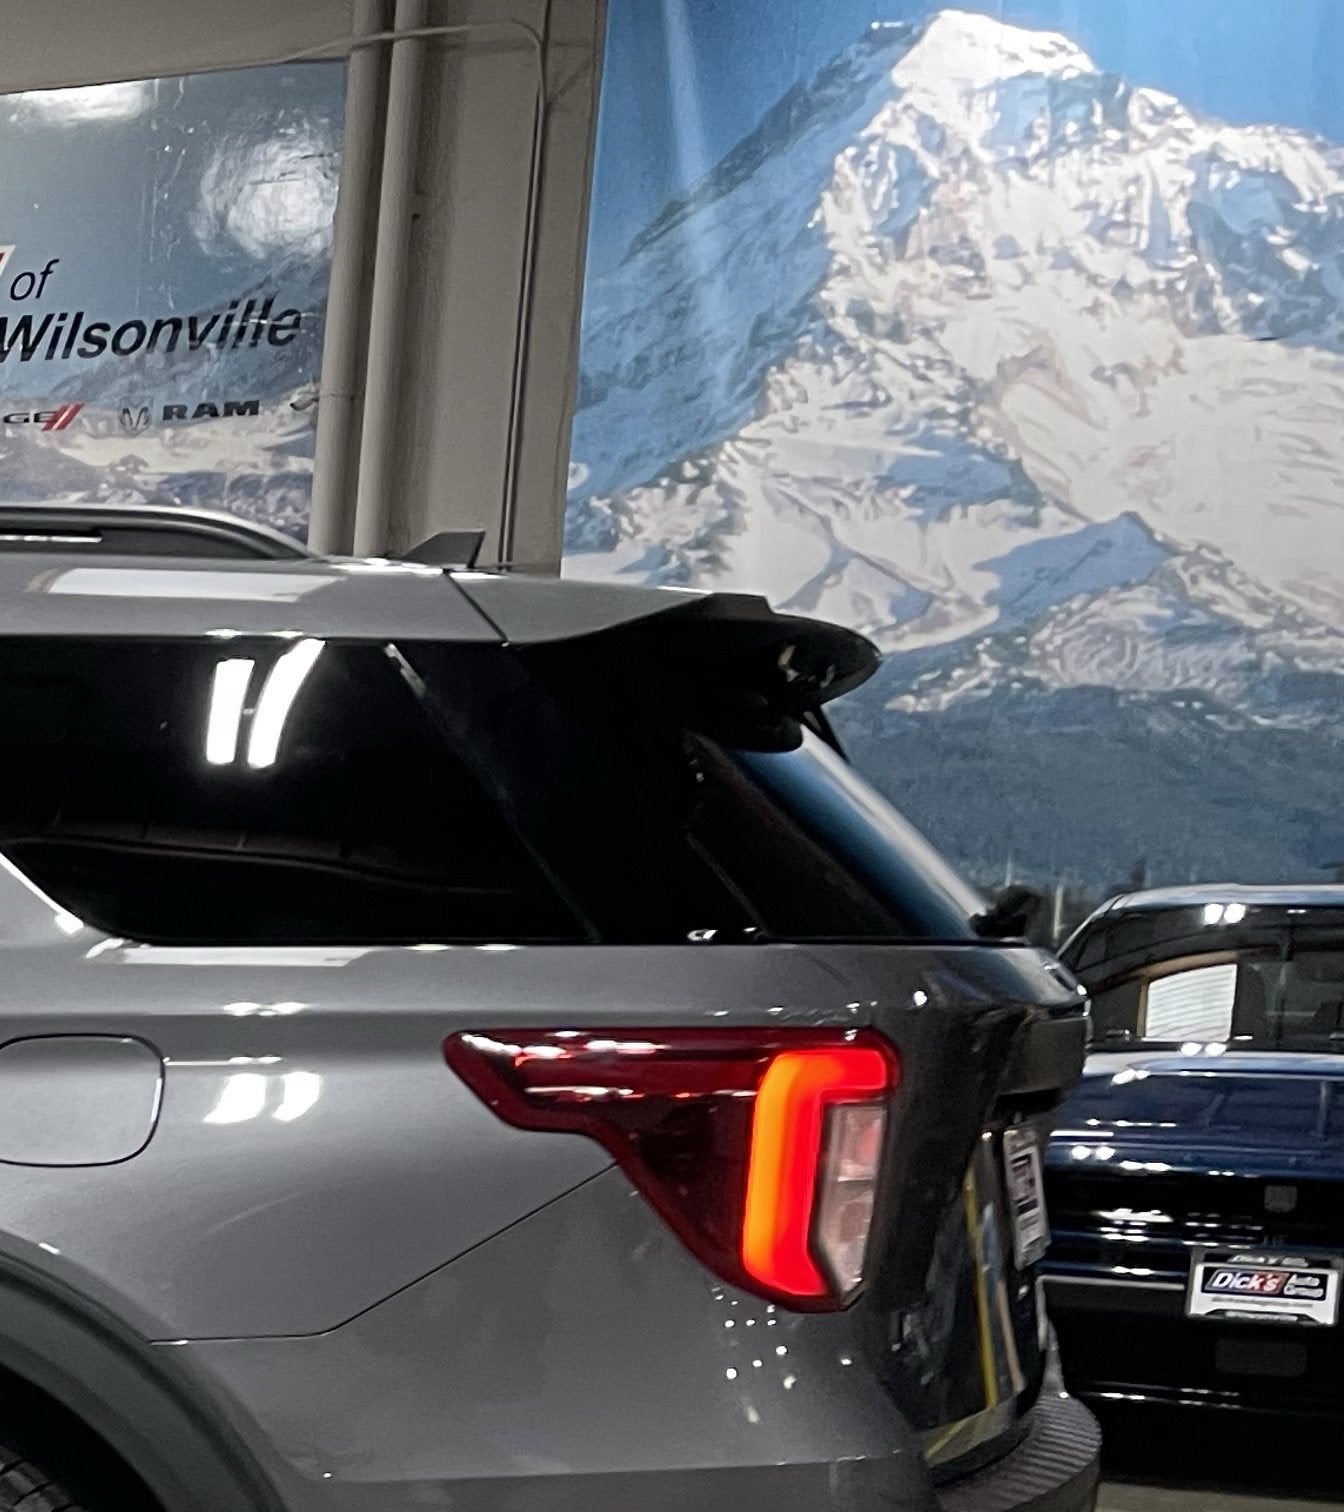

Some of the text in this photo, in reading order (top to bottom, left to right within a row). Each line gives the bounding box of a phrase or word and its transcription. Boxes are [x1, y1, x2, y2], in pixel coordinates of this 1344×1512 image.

[10, 259, 60, 300] of
[162, 400, 260, 420] RAM
[1212, 1272, 1279, 1292] Dick's
